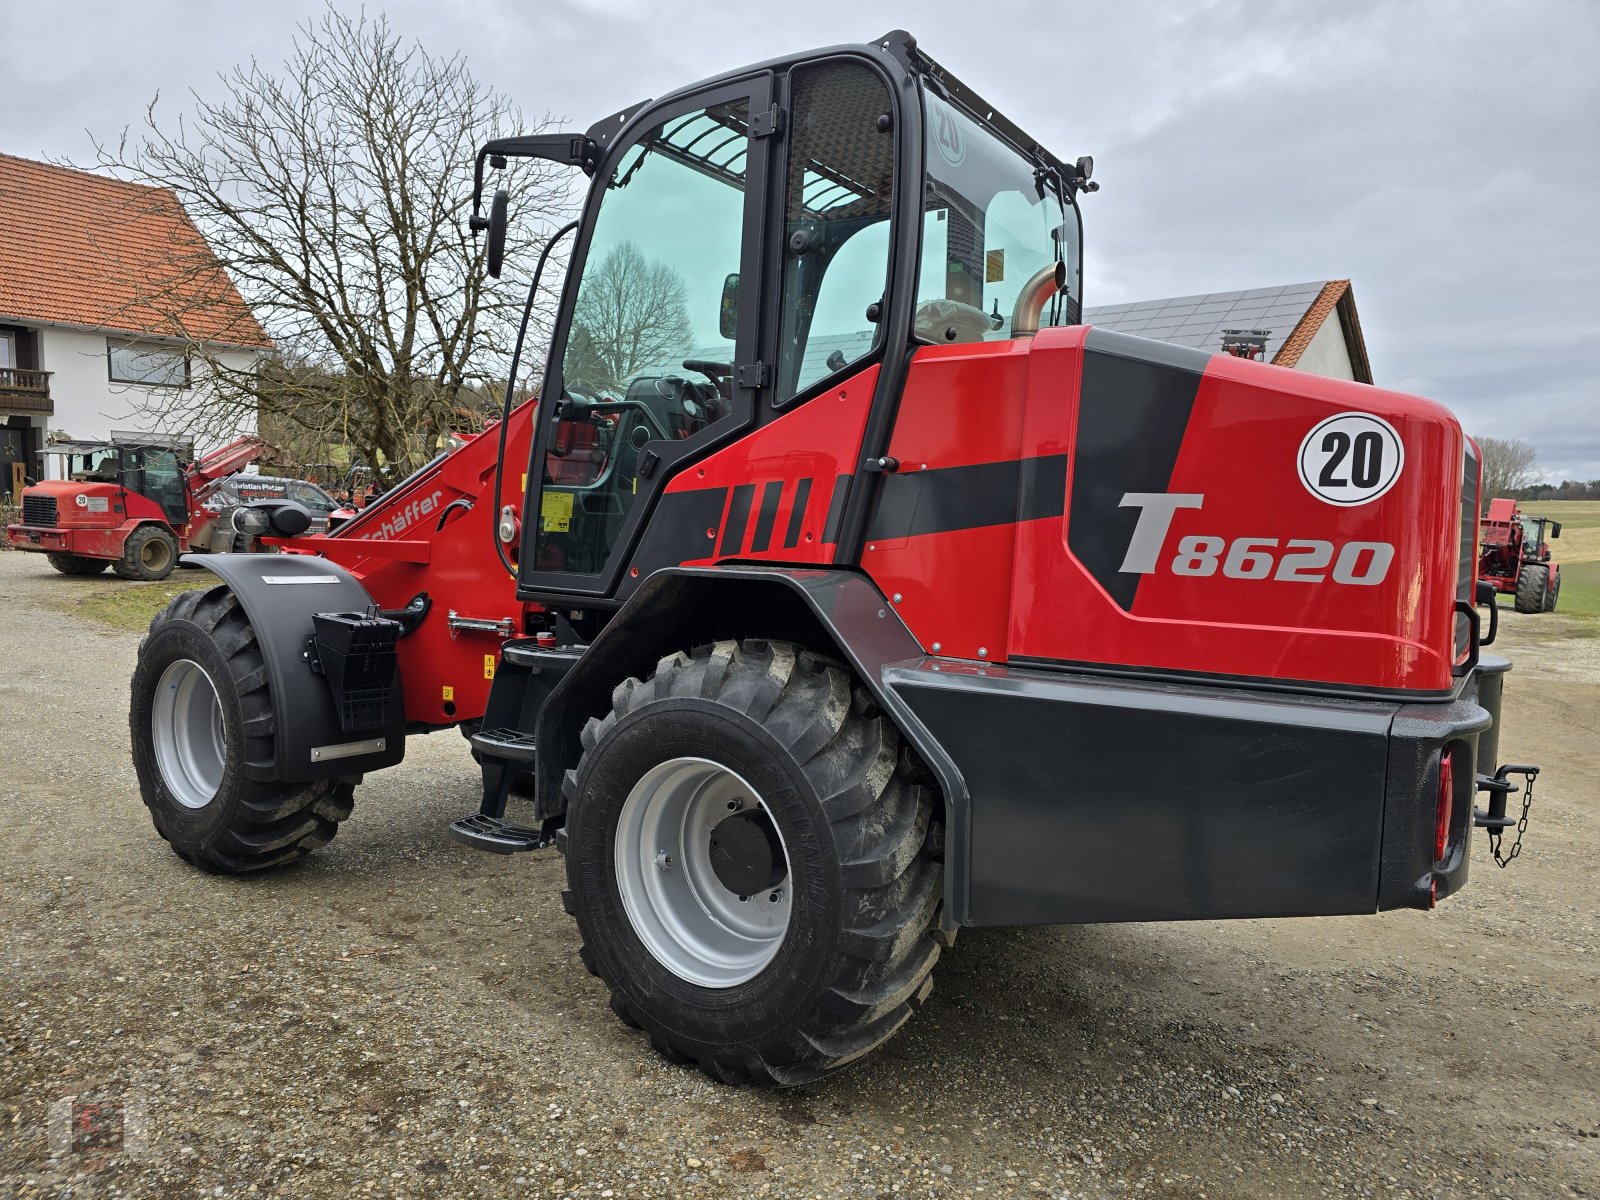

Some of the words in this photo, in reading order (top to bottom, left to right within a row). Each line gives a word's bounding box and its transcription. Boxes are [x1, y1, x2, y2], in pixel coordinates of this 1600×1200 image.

[934, 103, 960, 154] 20
[1318, 431, 1384, 489] 20
[78, 496, 86, 505] 20
